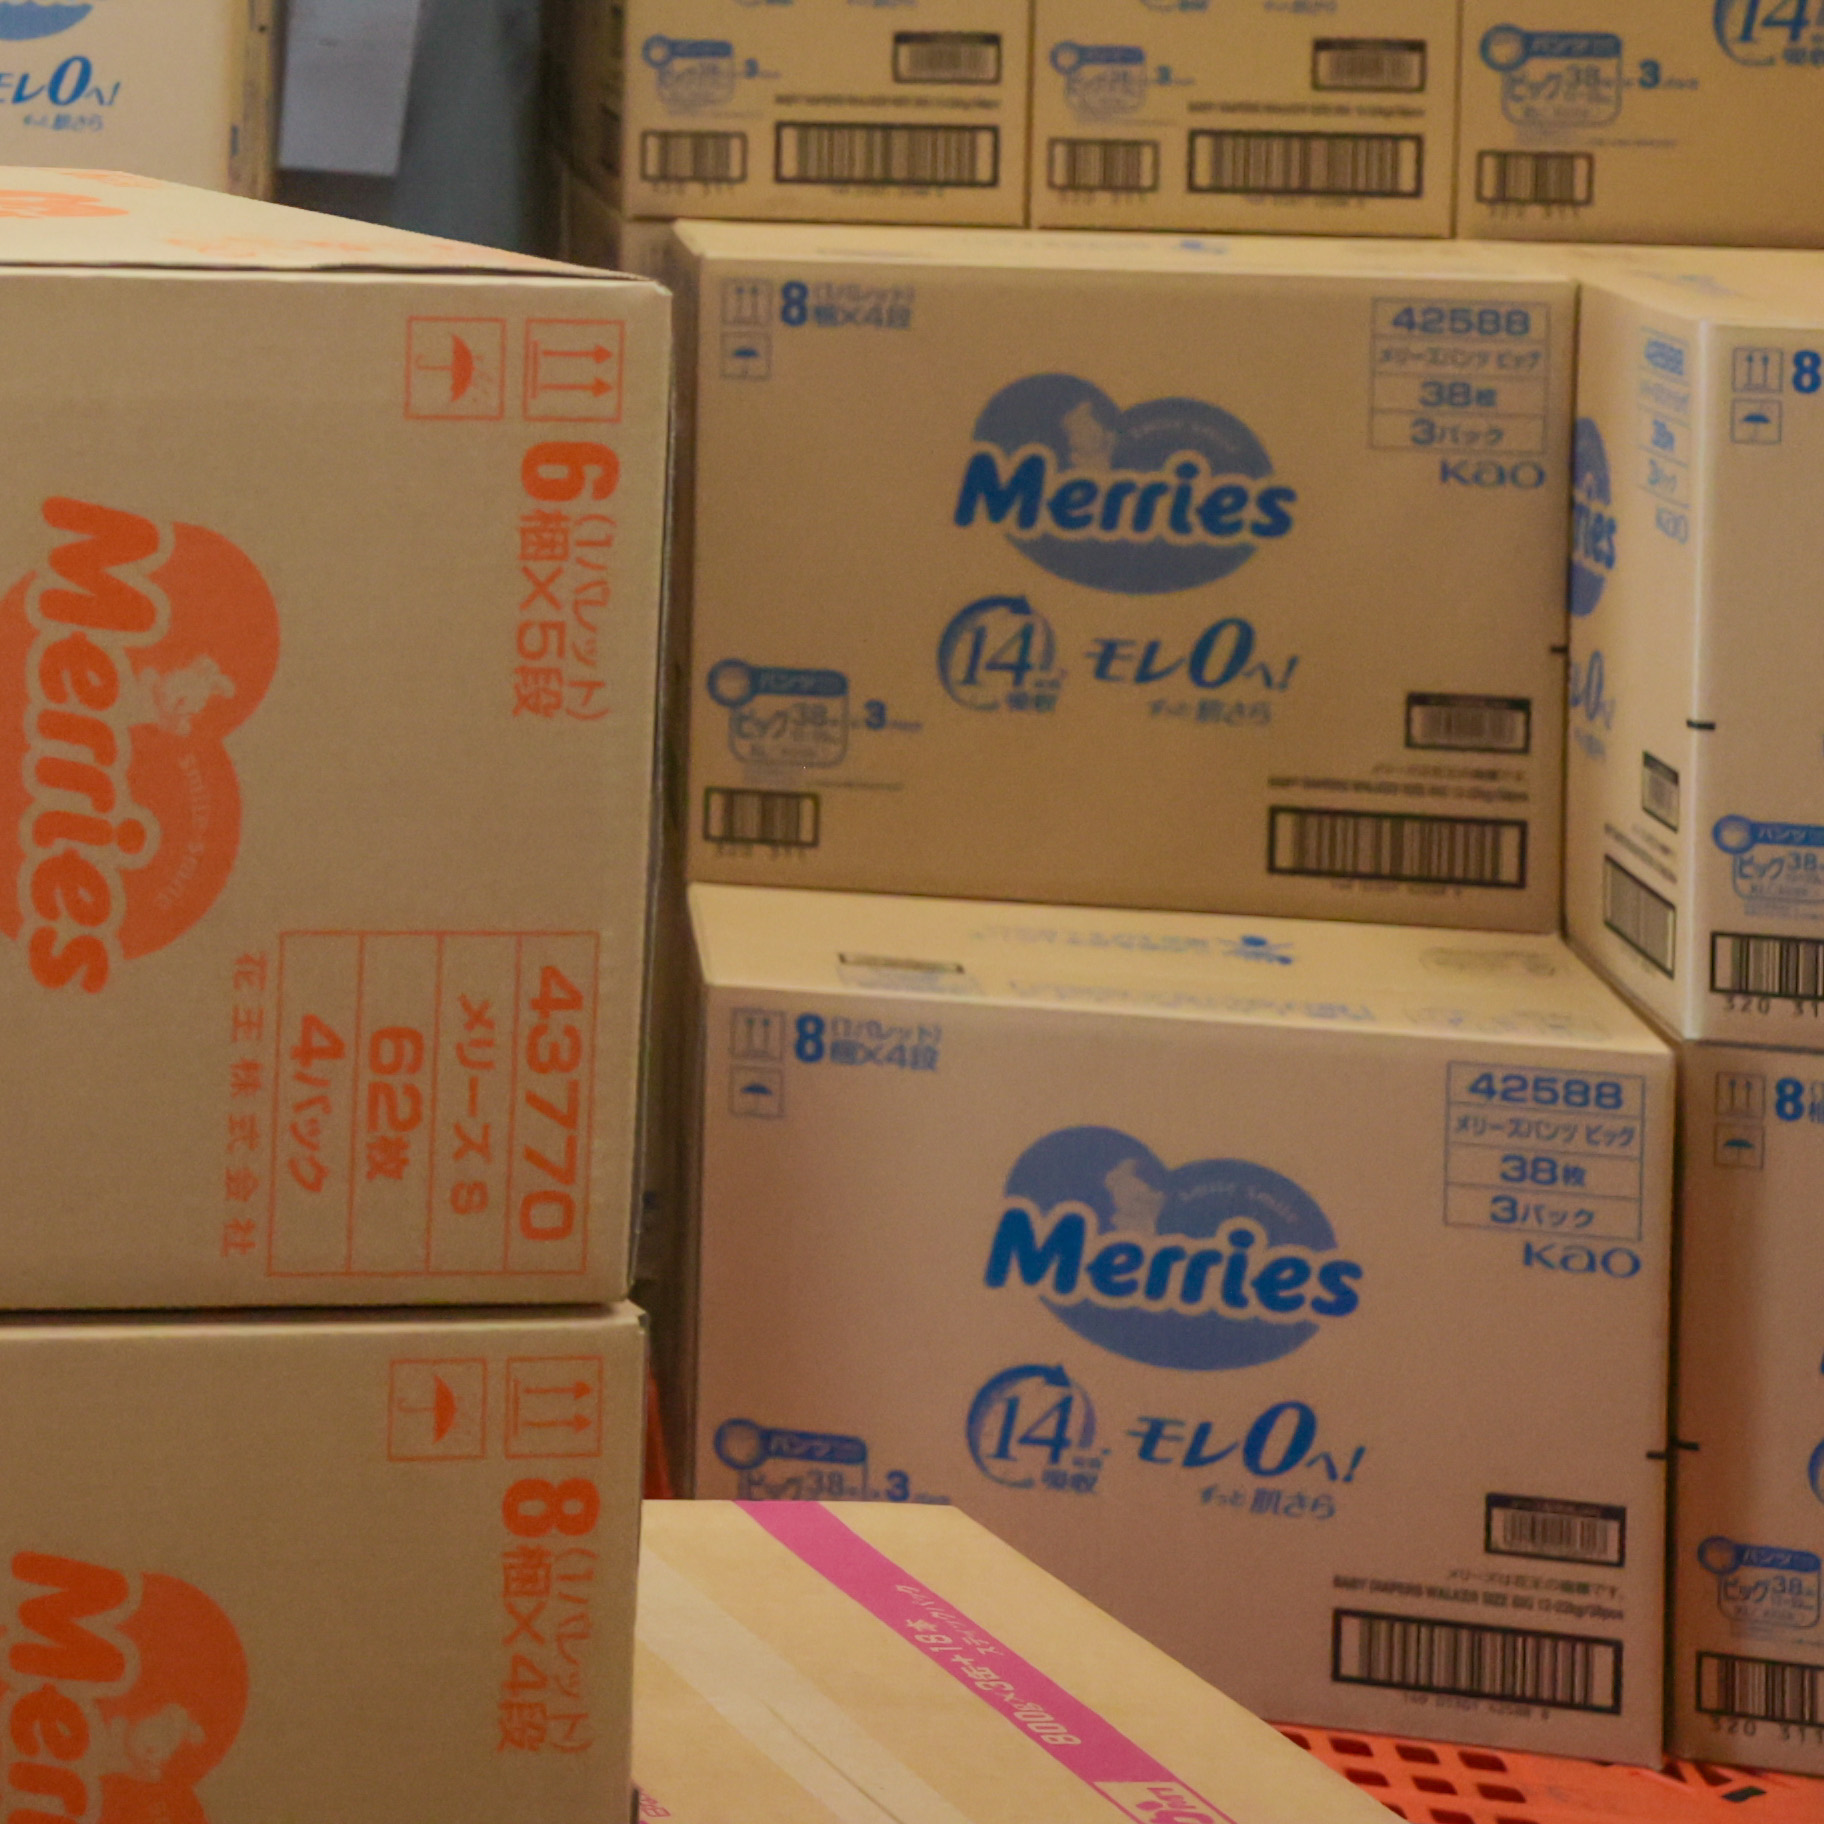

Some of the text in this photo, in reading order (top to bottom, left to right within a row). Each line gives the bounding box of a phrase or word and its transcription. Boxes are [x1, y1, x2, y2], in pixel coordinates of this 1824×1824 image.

[781, 282, 808, 327] 8
[1392, 307, 1531, 336] 42588
[1420, 382, 1498, 410] 38枚
[1793, 351, 1822, 395] 8
[1411, 420, 1504, 448] 3パック
[953, 453, 1298, 540] Merries
[512, 440, 621, 719] 6 梱×5段
[565, 513, 617, 721] (1パレット)
[960, 624, 1037, 689] 14
[29, 496, 160, 995] Merries
[793, 1014, 824, 1063] 8
[221, 951, 268, 1258] 花王株式会社
[289, 1013, 347, 1193] 4パック
[364, 1026, 425, 1182] 62枚
[520, 964, 585, 1242] 43770
[1468, 1073, 1623, 1110] 42588
[1774, 1078, 1803, 1121] 8
[1455, 1116, 1635, 1147] メリーズパンツ ビッグ
[451, 1180, 489, 1218] S
[1499, 1154, 1586, 1187] 38枚
[1489, 1195, 1594, 1228] 3パック
[984, 1208, 1364, 1318] Merries
[981, 1395, 1074, 1463] 14
[1200, 1483, 1336, 1520] ずっと肌さら
[498, 1478, 601, 1753] 8 梱×4段
[552, 1548, 598, 1755] (1パレット)
